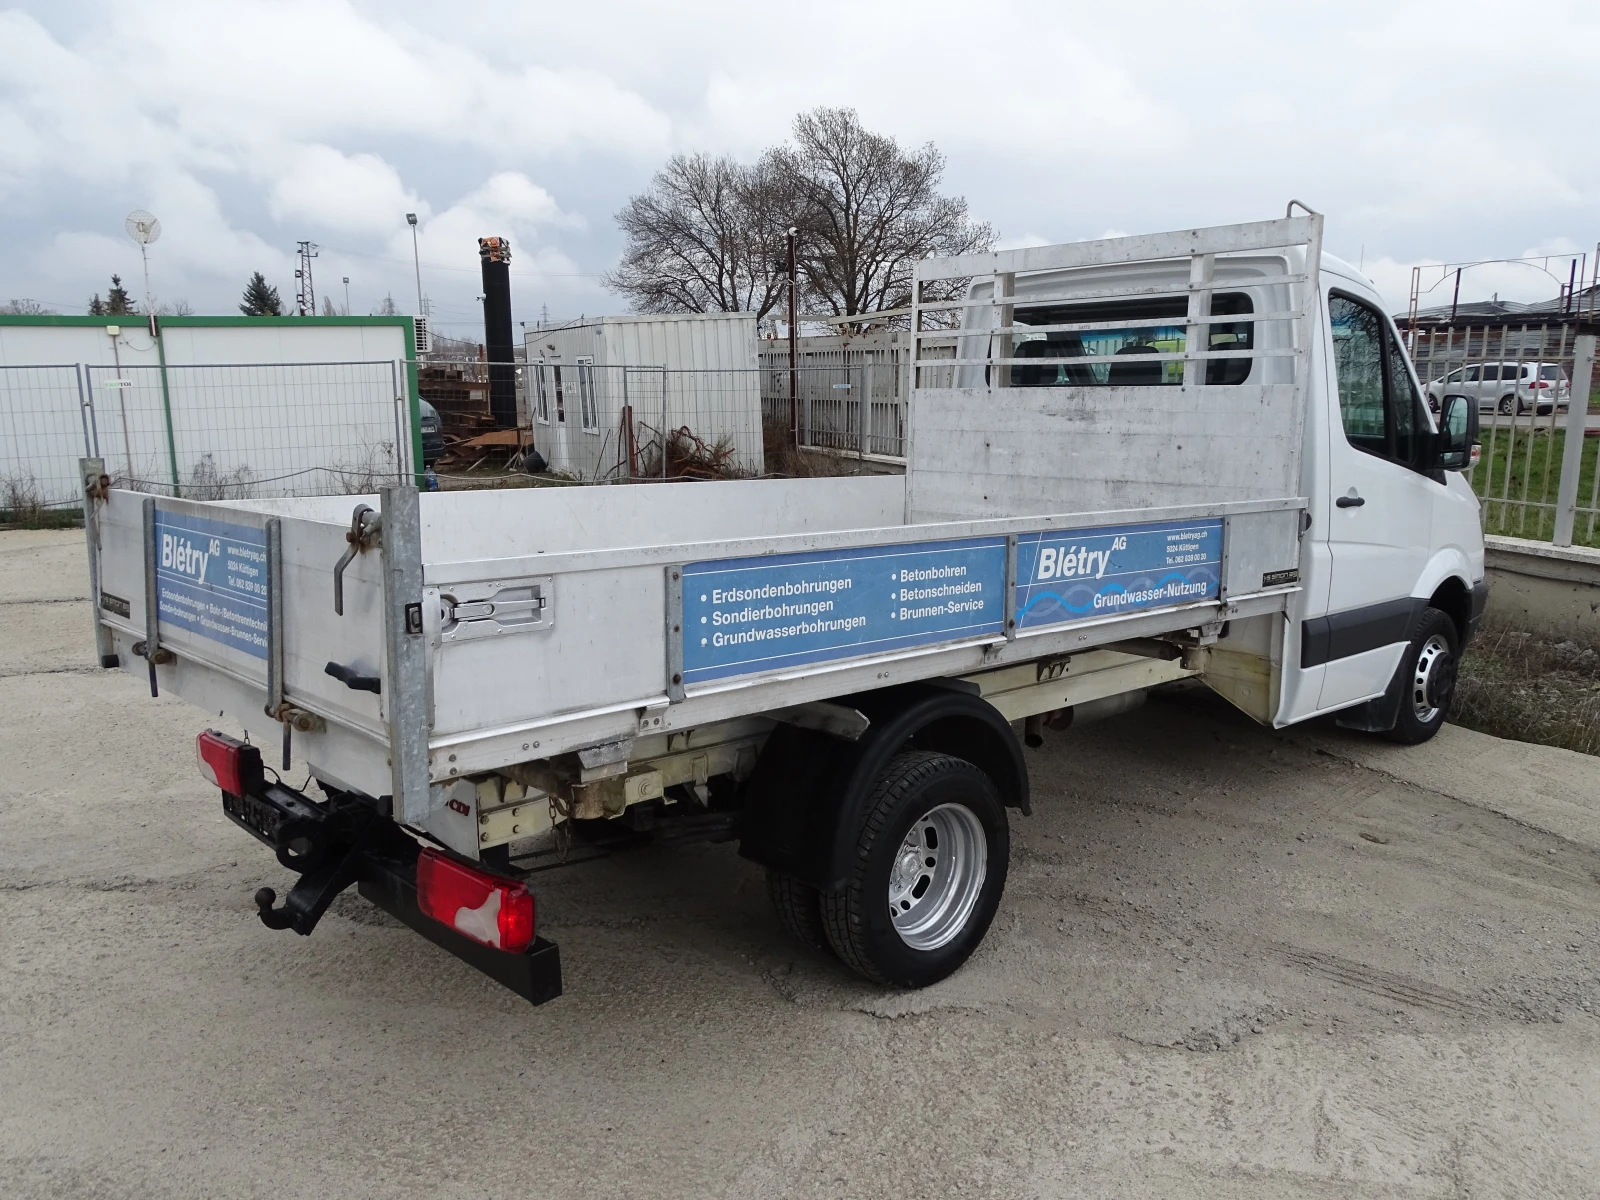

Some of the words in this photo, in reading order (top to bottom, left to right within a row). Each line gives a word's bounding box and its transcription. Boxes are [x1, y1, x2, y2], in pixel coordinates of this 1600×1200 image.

[162, 533, 209, 585] Blétry
[209, 539, 220, 557] AG
[1037, 546, 1111, 580] Blétry
[1111, 536, 1128, 551] AG
[900, 565, 967, 583] Betonbohren
[161, 587, 206, 612] Erdsondenbohrungen
[712, 577, 852, 605] Erdsondenbohrungen
[900, 580, 982, 602] Betonschneiden
[1093, 581, 1207, 609] Grundwasser-Nutzung
[712, 599, 834, 626] Sondierbohrungen
[900, 598, 984, 621] Brunnen-Service
[159, 600, 197, 623] Sondierbohrungen
[200, 614, 268, 648] Grundwasser-Brunnen-Servi
[712, 615, 867, 648] Grundwasserbohrungen
[449, 799, 470, 816] CDI
